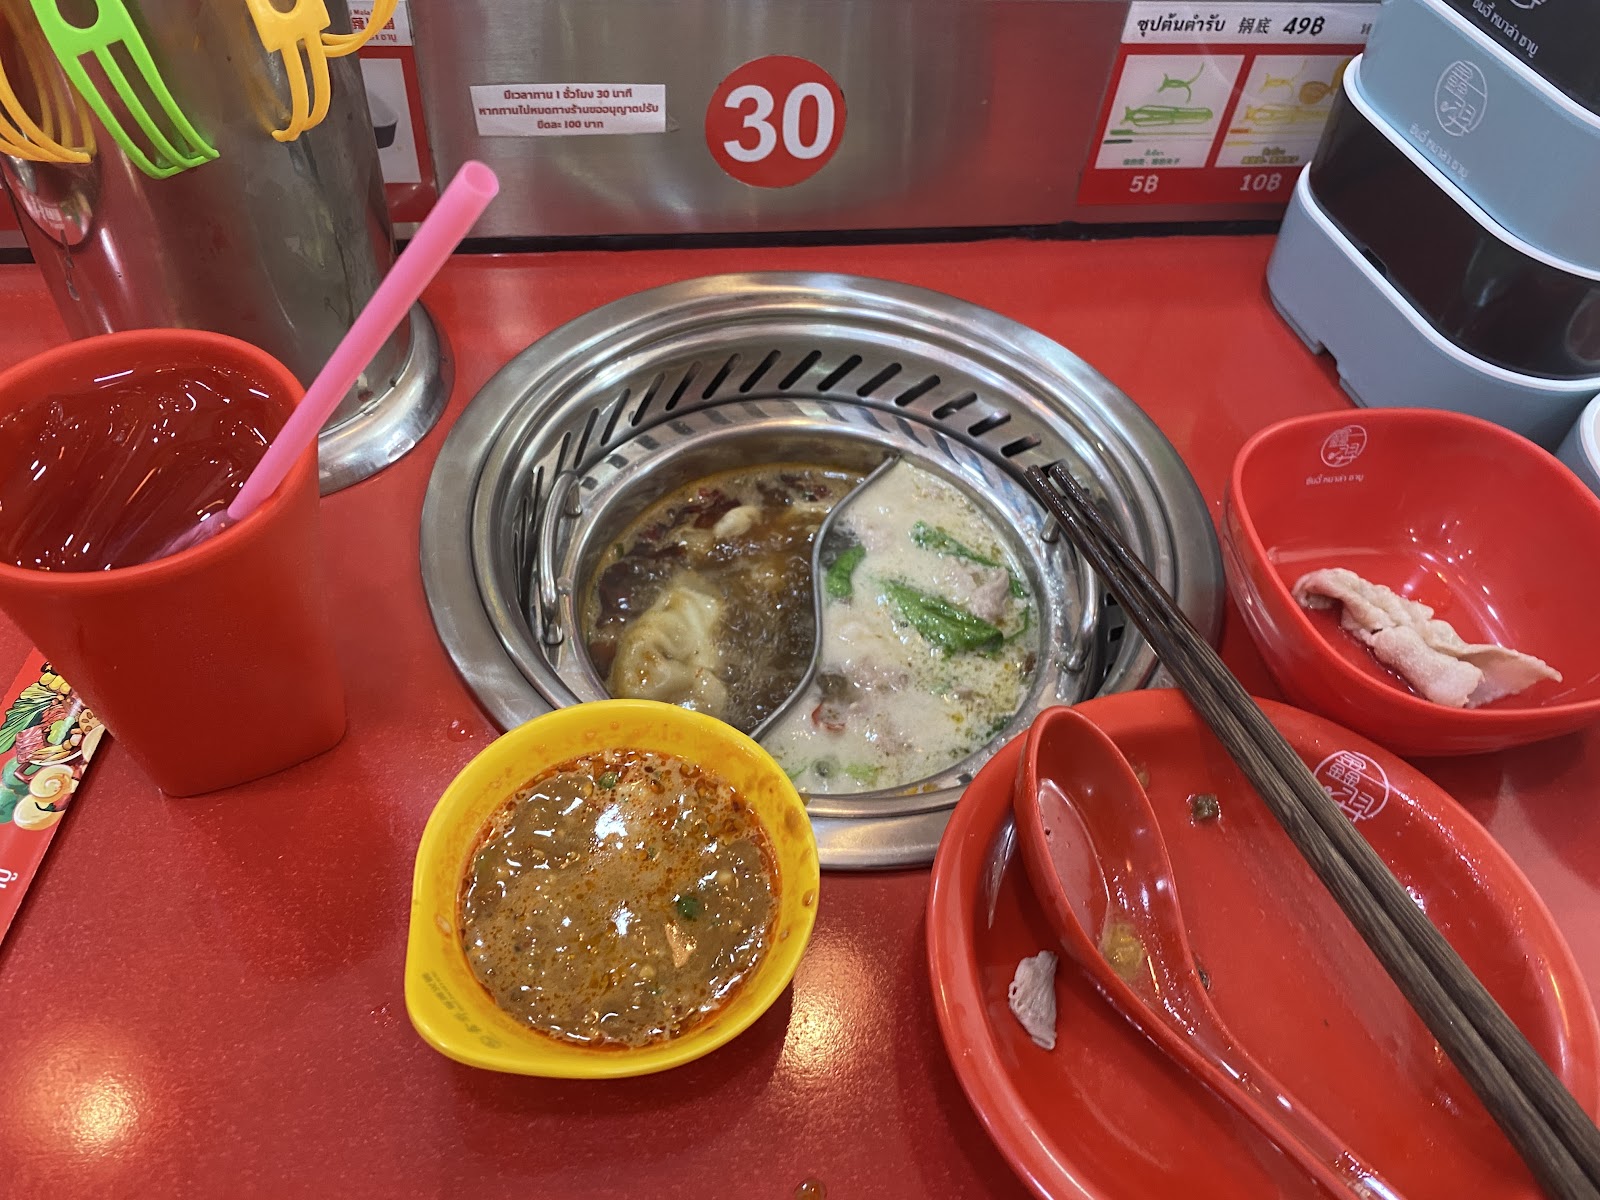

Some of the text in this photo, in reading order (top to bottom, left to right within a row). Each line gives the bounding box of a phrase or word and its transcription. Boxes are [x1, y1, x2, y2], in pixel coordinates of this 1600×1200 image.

[1137, 14, 1226, 38] ซุปต้นตำรับ
[1518, 34, 1539, 59] ชาบู
[563, 86, 594, 99] ชั่วโมง
[596, 89, 610, 99] 30
[612, 88, 633, 98] นาที
[564, 120, 581, 129] 100
[584, 120, 604, 129] บาท
[723, 82, 835, 163] 30
